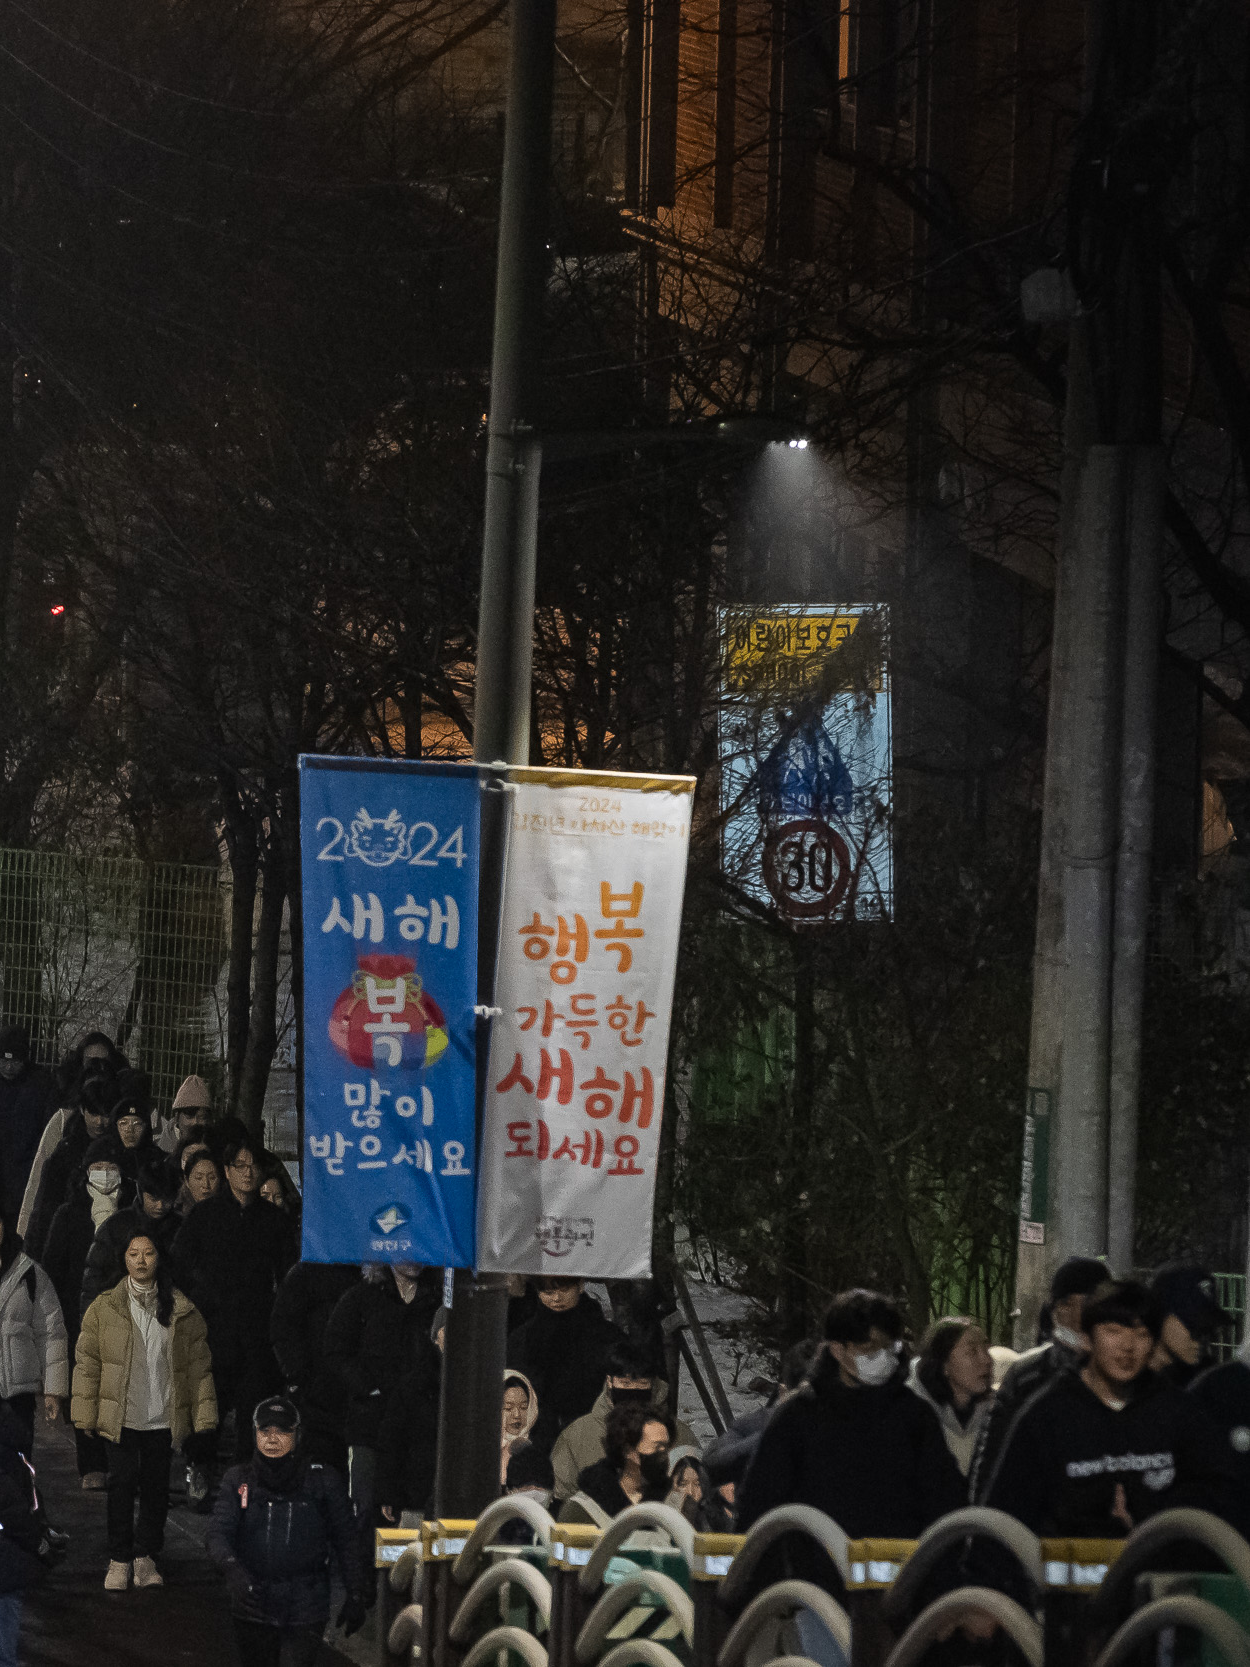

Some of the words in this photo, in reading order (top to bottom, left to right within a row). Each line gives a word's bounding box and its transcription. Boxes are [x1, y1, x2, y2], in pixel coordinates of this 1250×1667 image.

[579, 797, 622, 814] 2024
[780, 841, 833, 892] 30
[321, 893, 460, 950] 새해
[518, 881, 646, 985] 행복
[363, 977, 411, 1067] 복
[516, 993, 656, 1051] 가득한
[343, 1078, 434, 1127] 많이
[496, 1047, 654, 1129] 새해
[309, 1133, 471, 1178] 받으세요
[504, 1121, 645, 1177] 되세요
[1066, 1459, 1103, 1478] new
